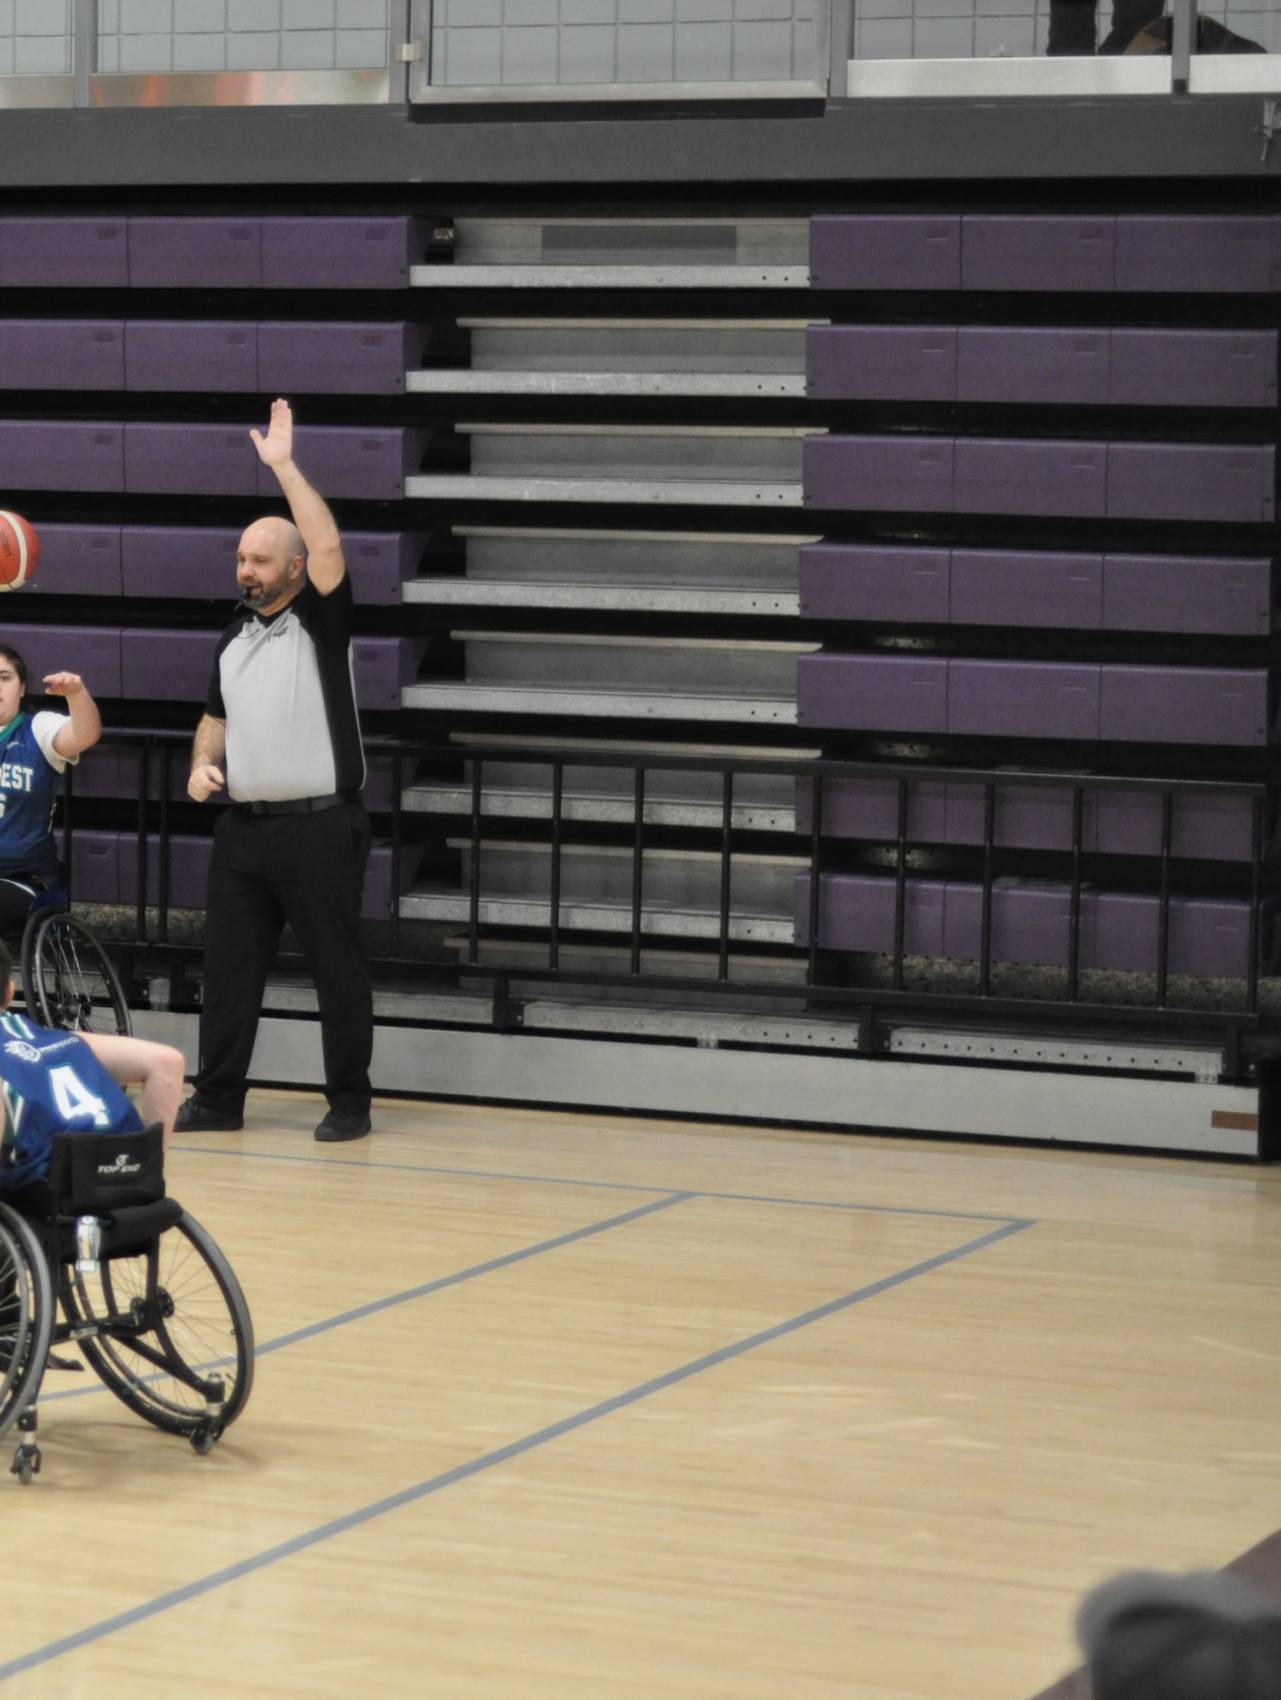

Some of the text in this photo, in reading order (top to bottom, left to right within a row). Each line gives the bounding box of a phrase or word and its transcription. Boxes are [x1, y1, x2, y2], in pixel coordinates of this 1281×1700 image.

[49, 1065, 109, 1126] 4
[97, 1163, 141, 1174] TOP END
